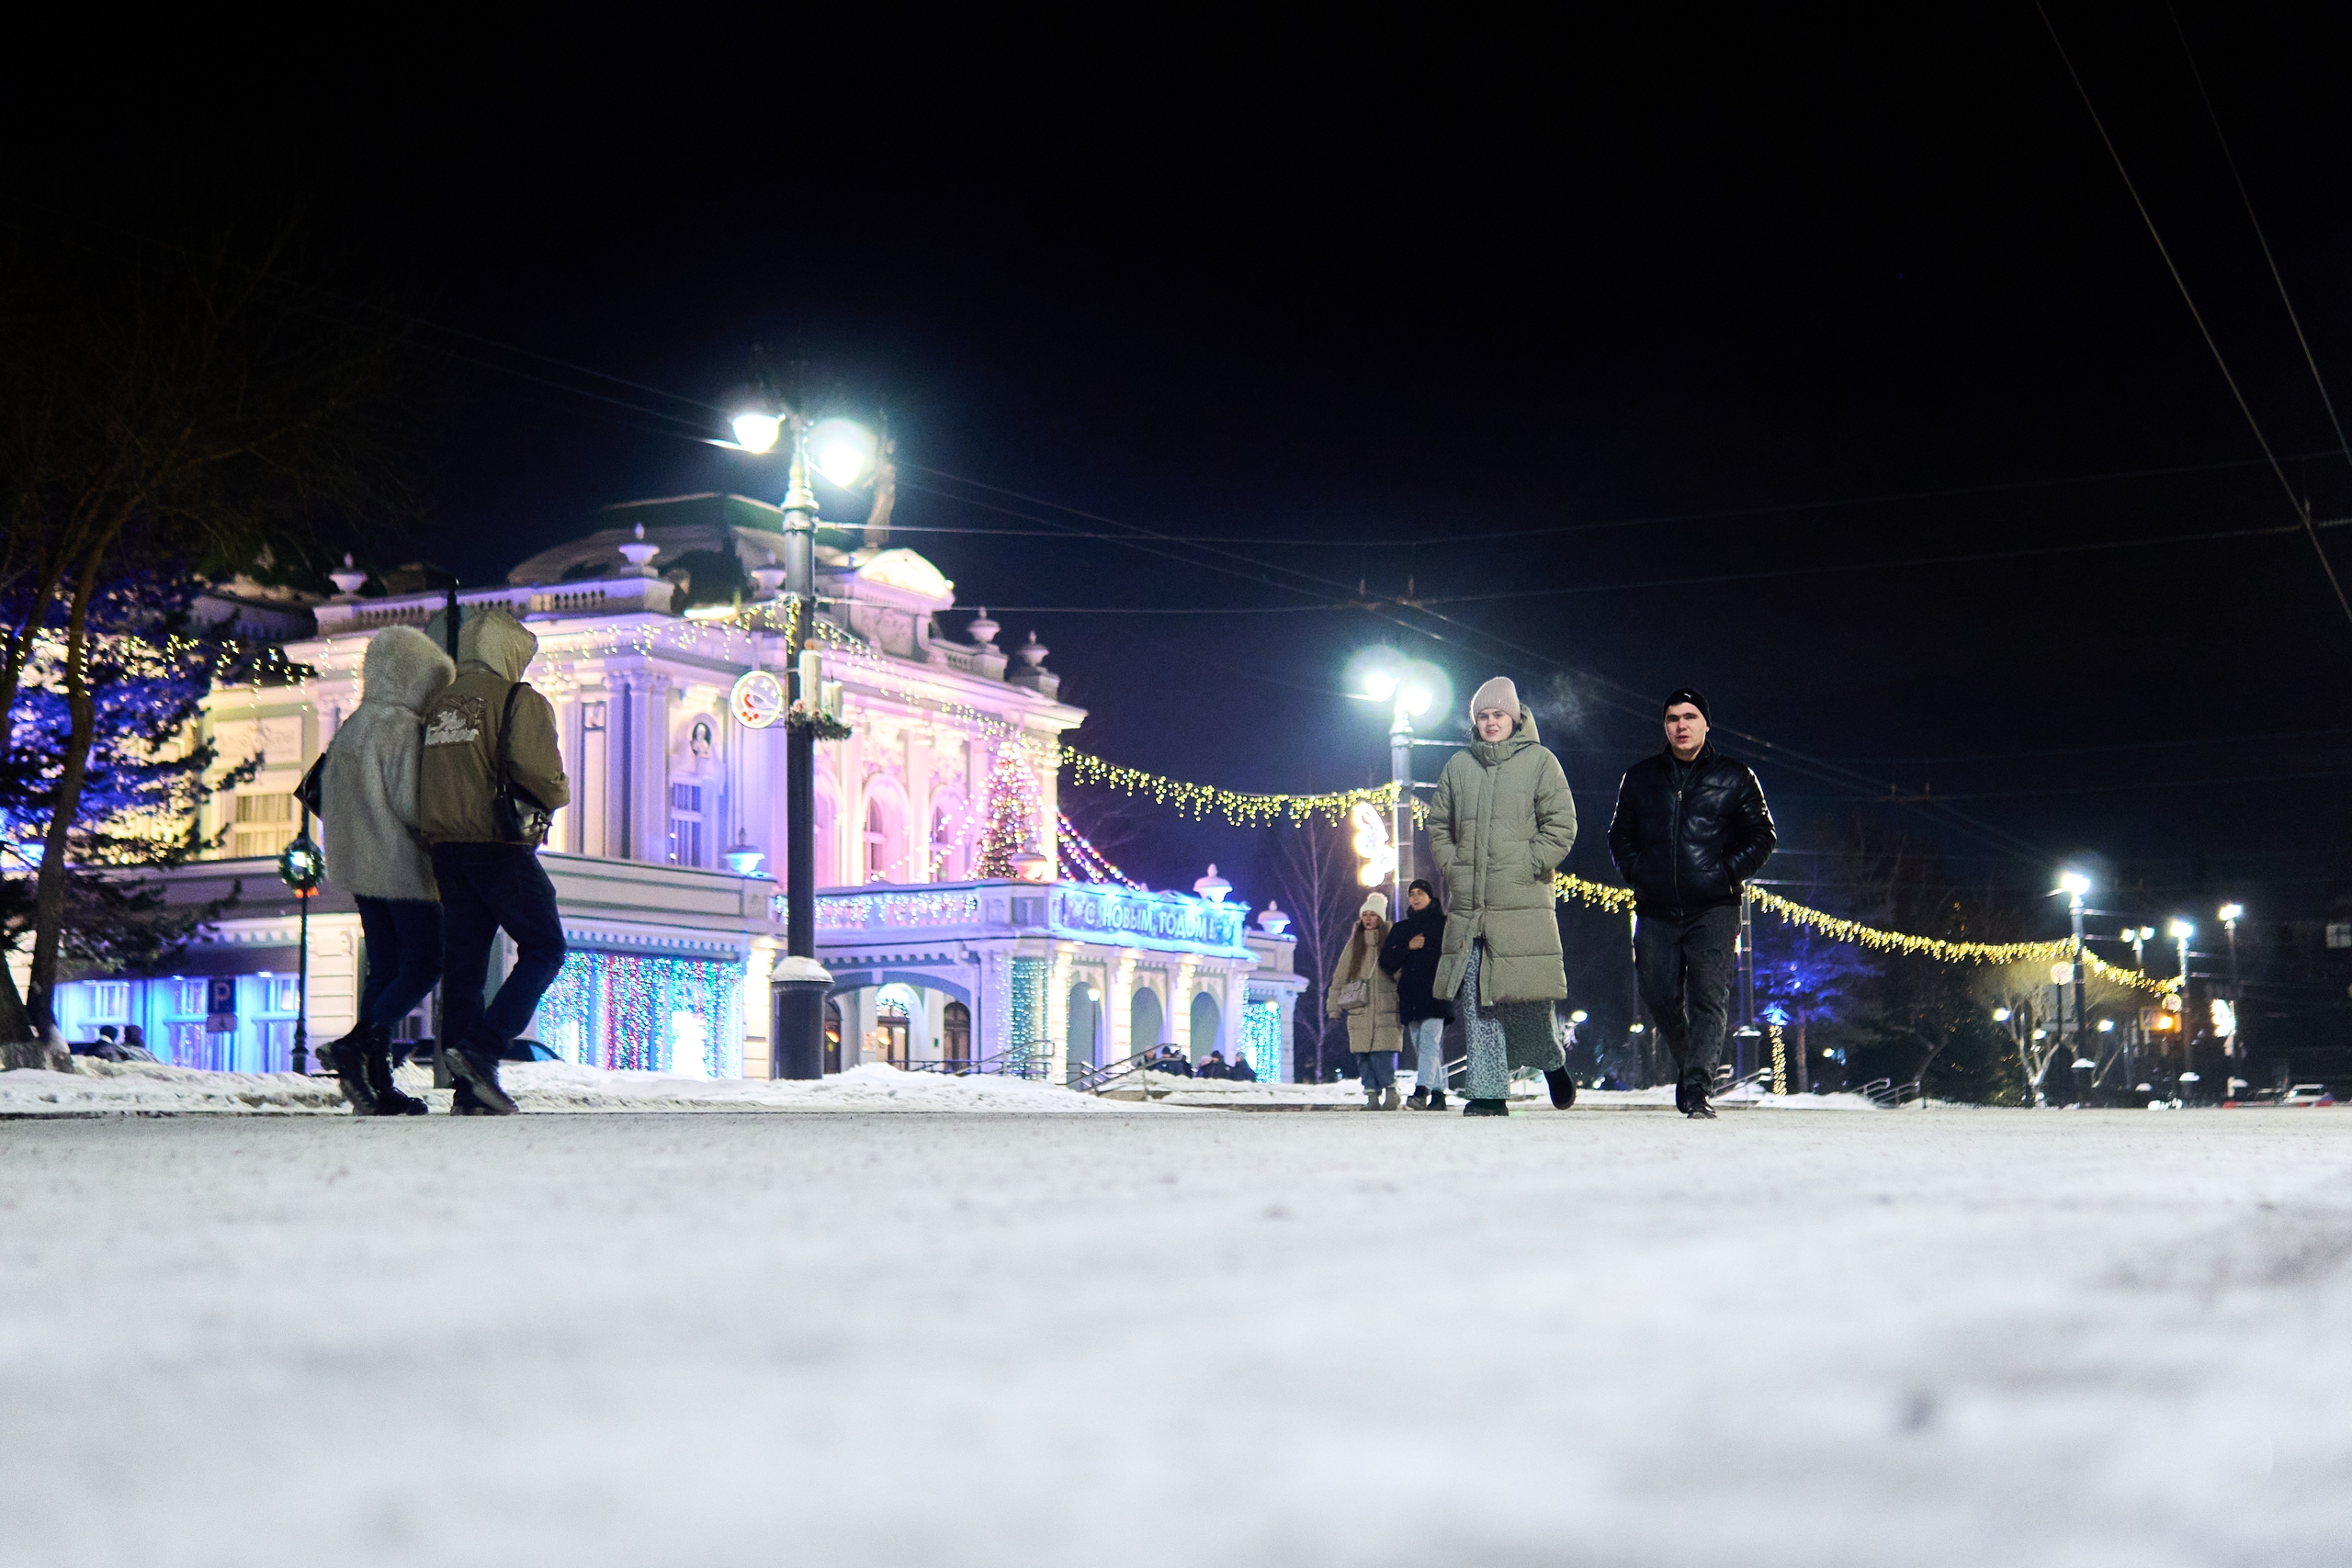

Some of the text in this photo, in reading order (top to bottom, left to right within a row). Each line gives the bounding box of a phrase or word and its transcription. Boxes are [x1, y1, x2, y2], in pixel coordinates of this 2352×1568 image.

[1084, 902, 1095, 925] С
[1102, 904, 1153, 932] НОВЫМ
[213, 982, 231, 1010] P
